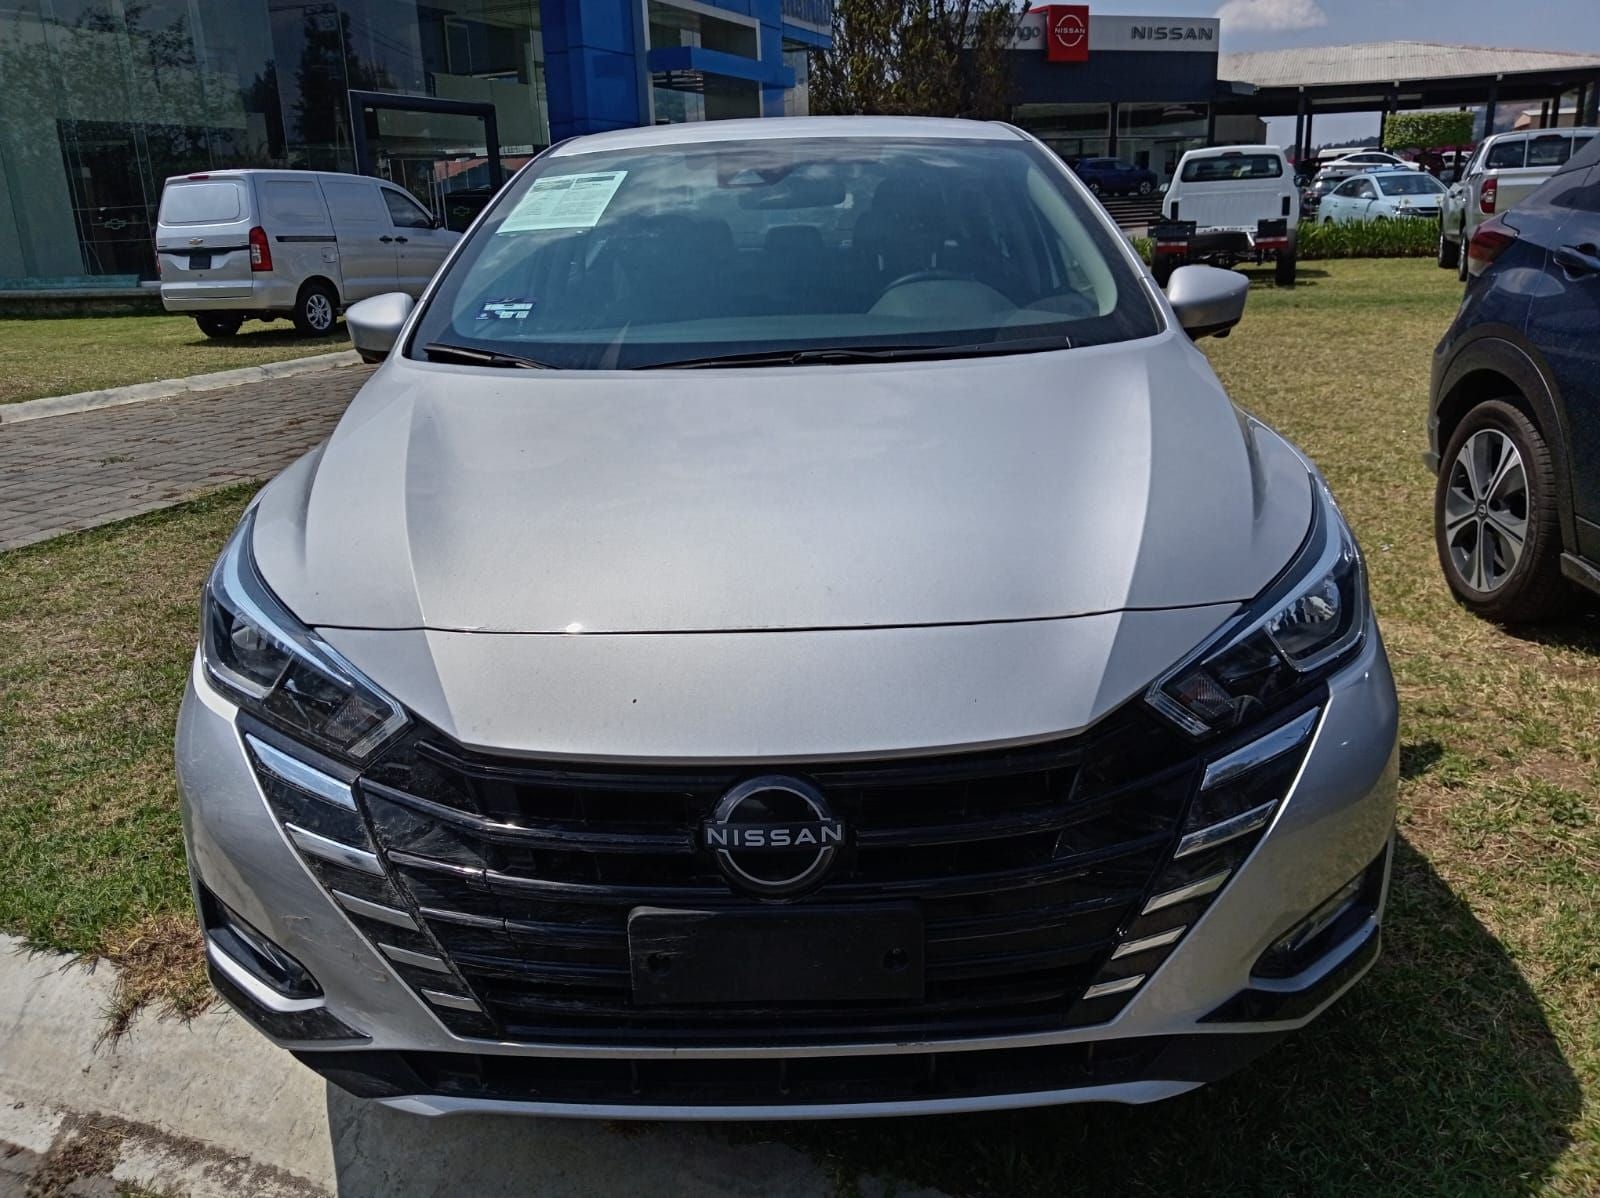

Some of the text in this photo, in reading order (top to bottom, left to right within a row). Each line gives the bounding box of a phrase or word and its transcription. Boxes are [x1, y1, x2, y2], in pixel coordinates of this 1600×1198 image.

[1054, 26, 1086, 34] NISSAN
[1131, 26, 1213, 41] NISSAN
[706, 823, 843, 847] NISSAN
